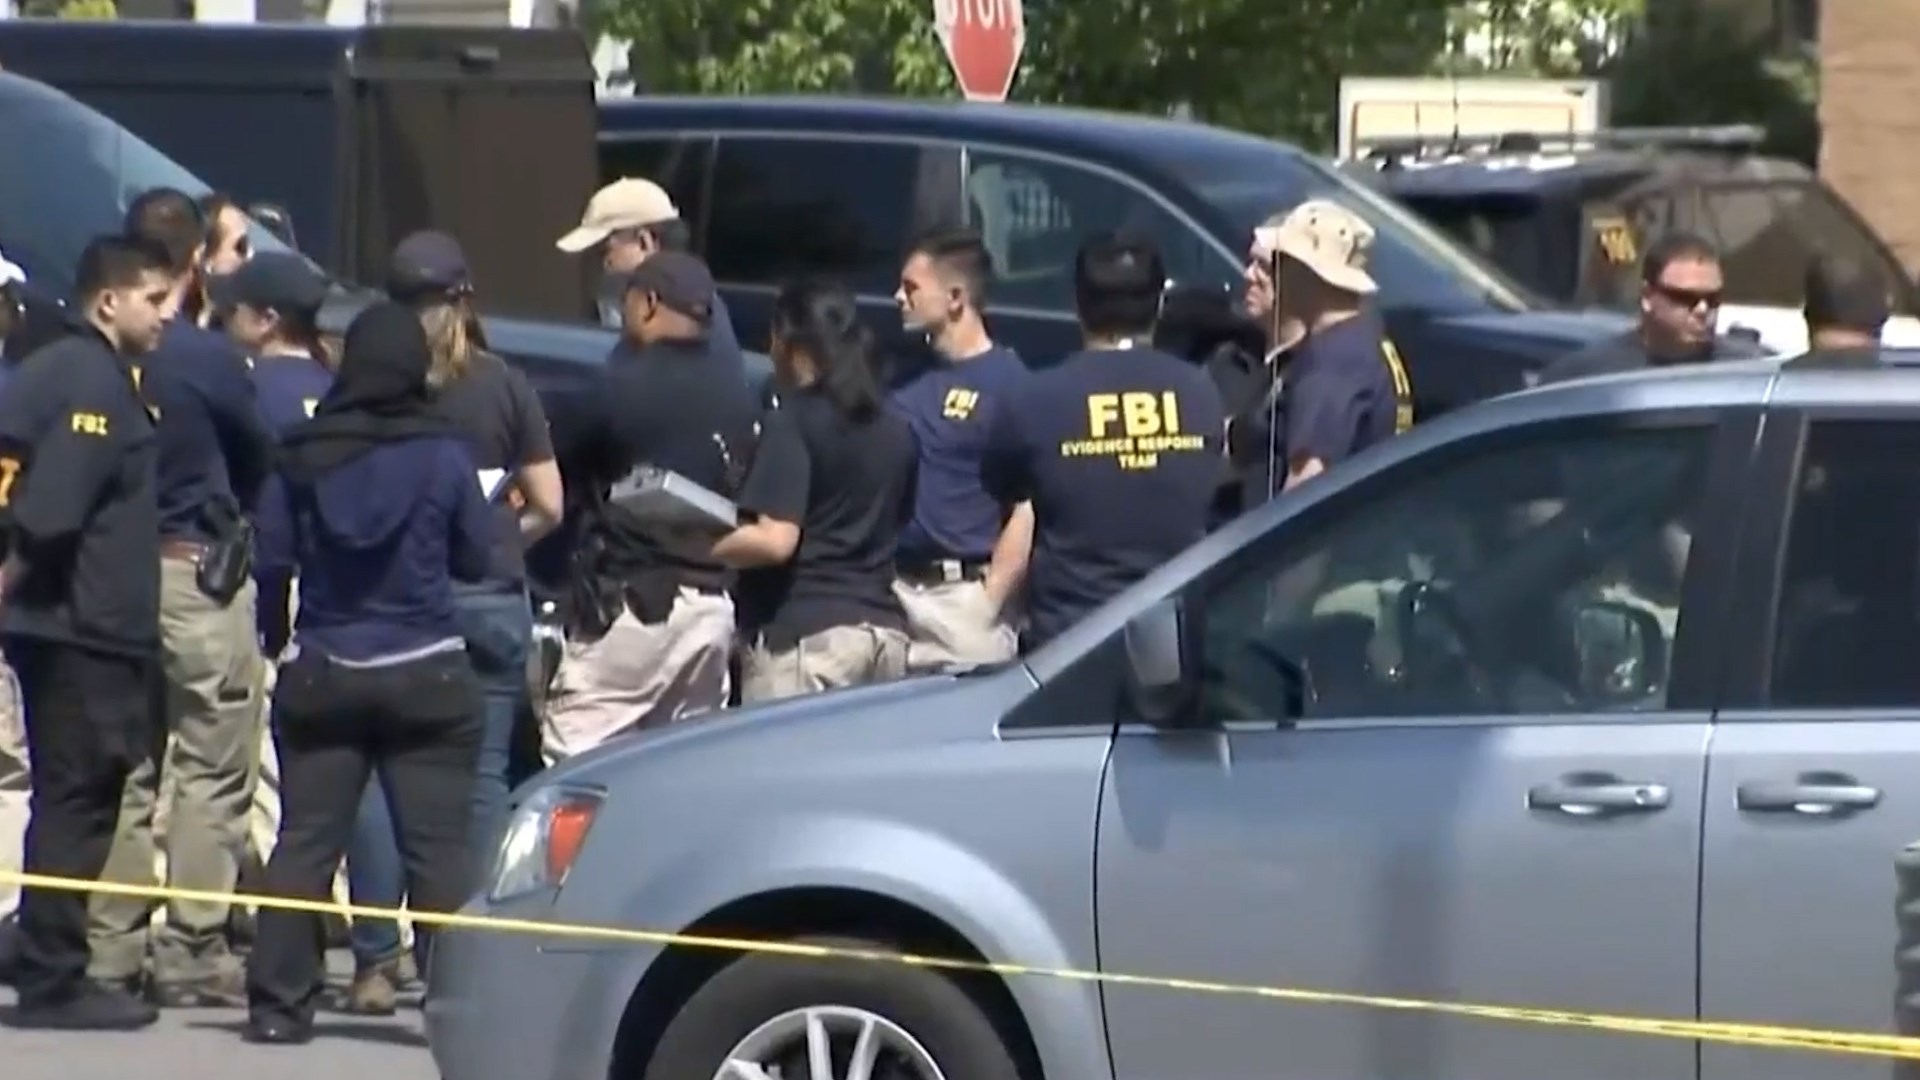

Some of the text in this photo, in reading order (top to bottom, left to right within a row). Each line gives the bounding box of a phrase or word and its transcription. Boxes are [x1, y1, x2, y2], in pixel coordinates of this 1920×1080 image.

[944, 389, 979, 409] FBI
[72, 412, 107, 435] FBI
[1088, 391, 1179, 437] FBI
[1061, 439, 1133, 456] EVIDENCE
[1118, 454, 1158, 469] TEAM
